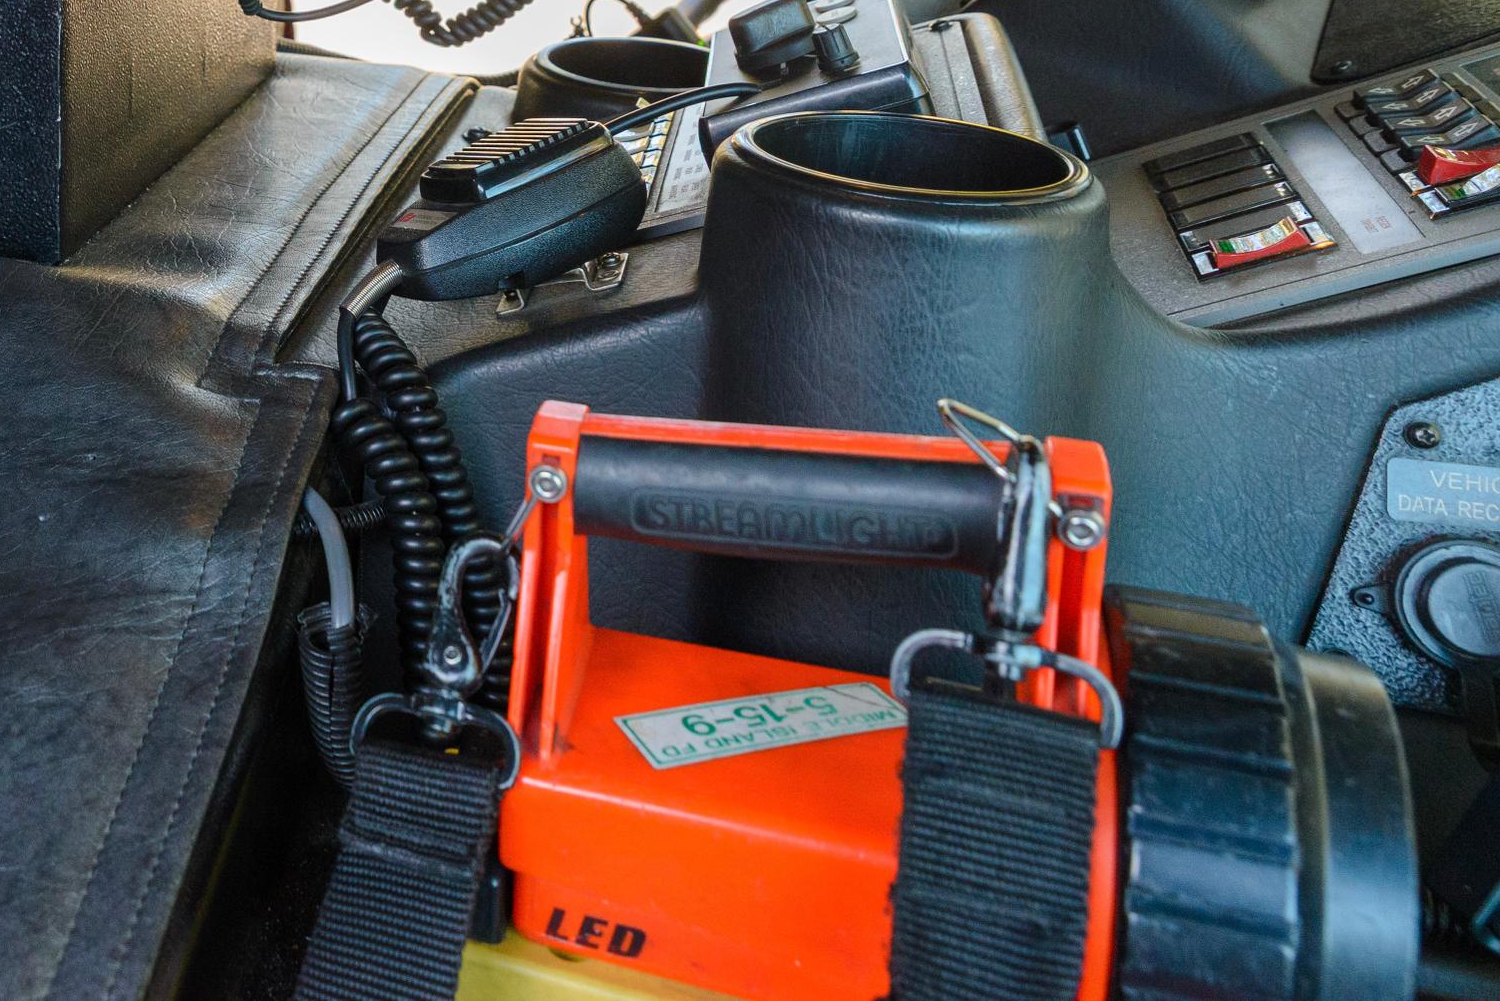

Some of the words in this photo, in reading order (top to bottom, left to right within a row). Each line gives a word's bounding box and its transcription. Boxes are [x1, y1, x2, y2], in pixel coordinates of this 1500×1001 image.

[1399, 495, 1448, 517] DATA
[681, 696, 838, 737] 5-15-9
[801, 709, 898, 734] MIDDLE
[705, 726, 799, 749] ISLAND
[661, 744, 697, 758] FD
[546, 907, 647, 958] LED
